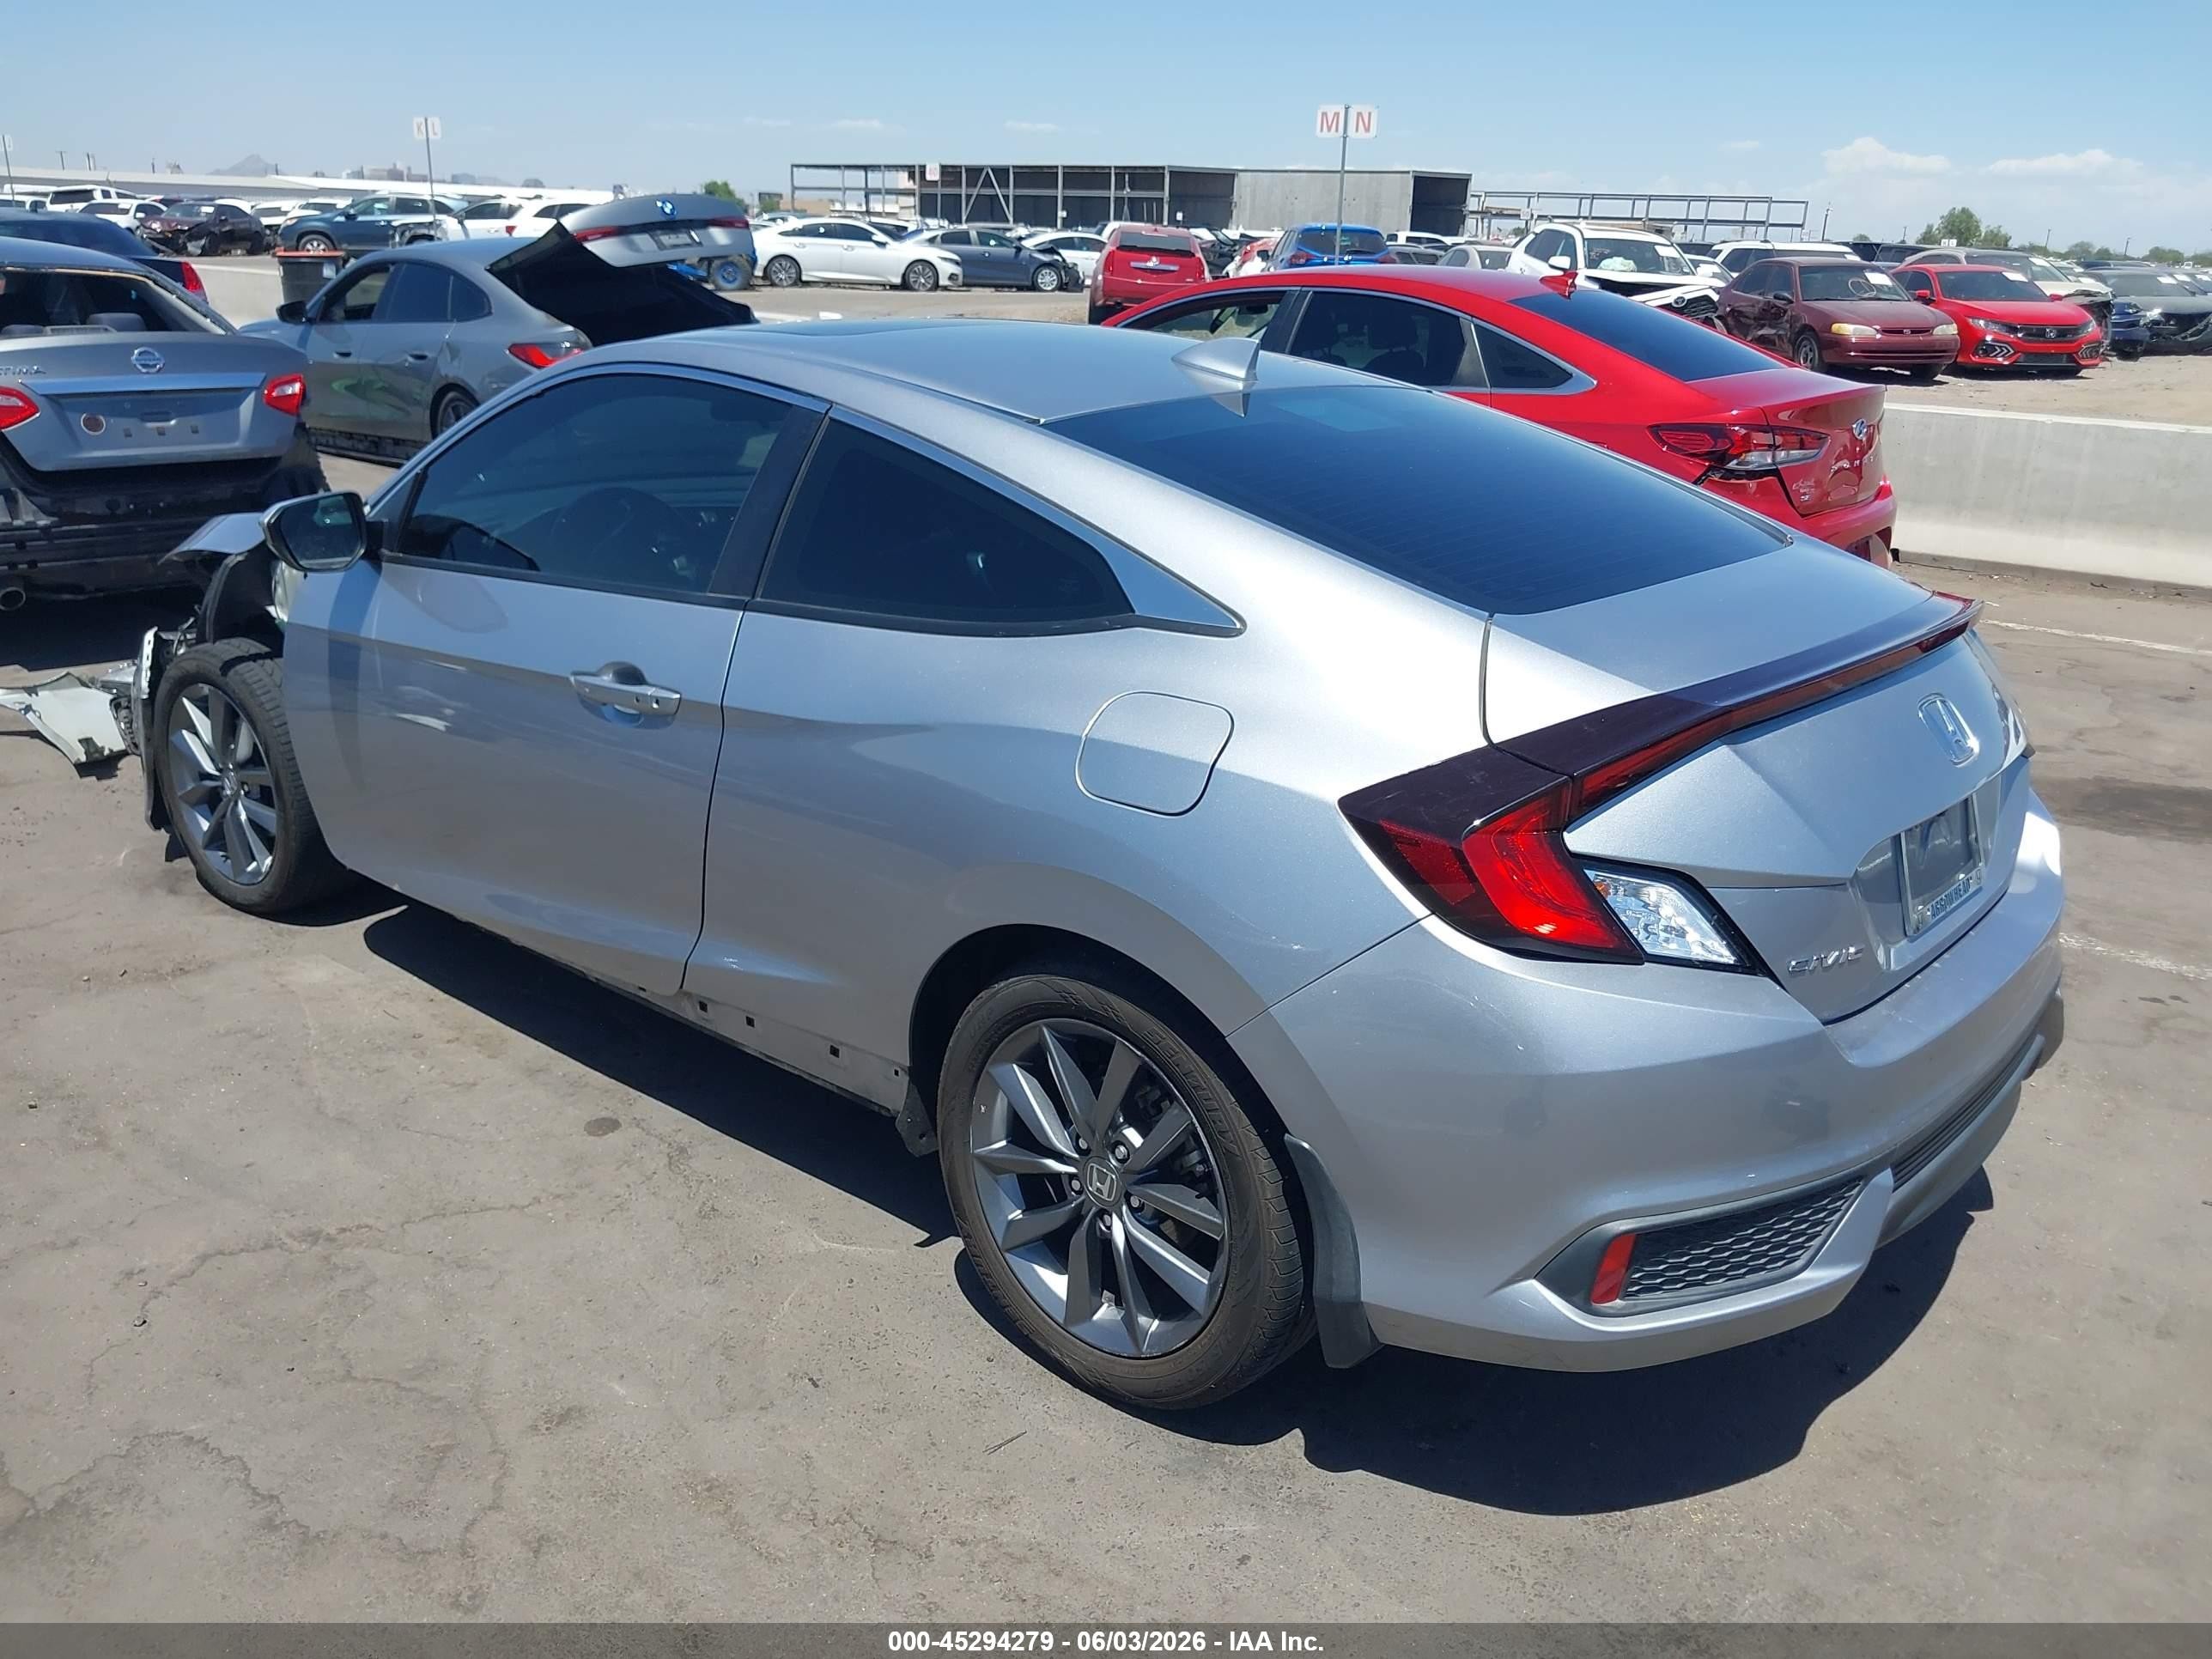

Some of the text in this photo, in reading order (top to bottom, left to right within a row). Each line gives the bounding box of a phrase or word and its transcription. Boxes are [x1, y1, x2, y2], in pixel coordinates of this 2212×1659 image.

[431, 121, 439, 137] L
[1319, 111, 1372, 133] M N
[1931, 878, 1971, 920] ARROWHEAD
[1789, 945, 1865, 971] CIVIC
